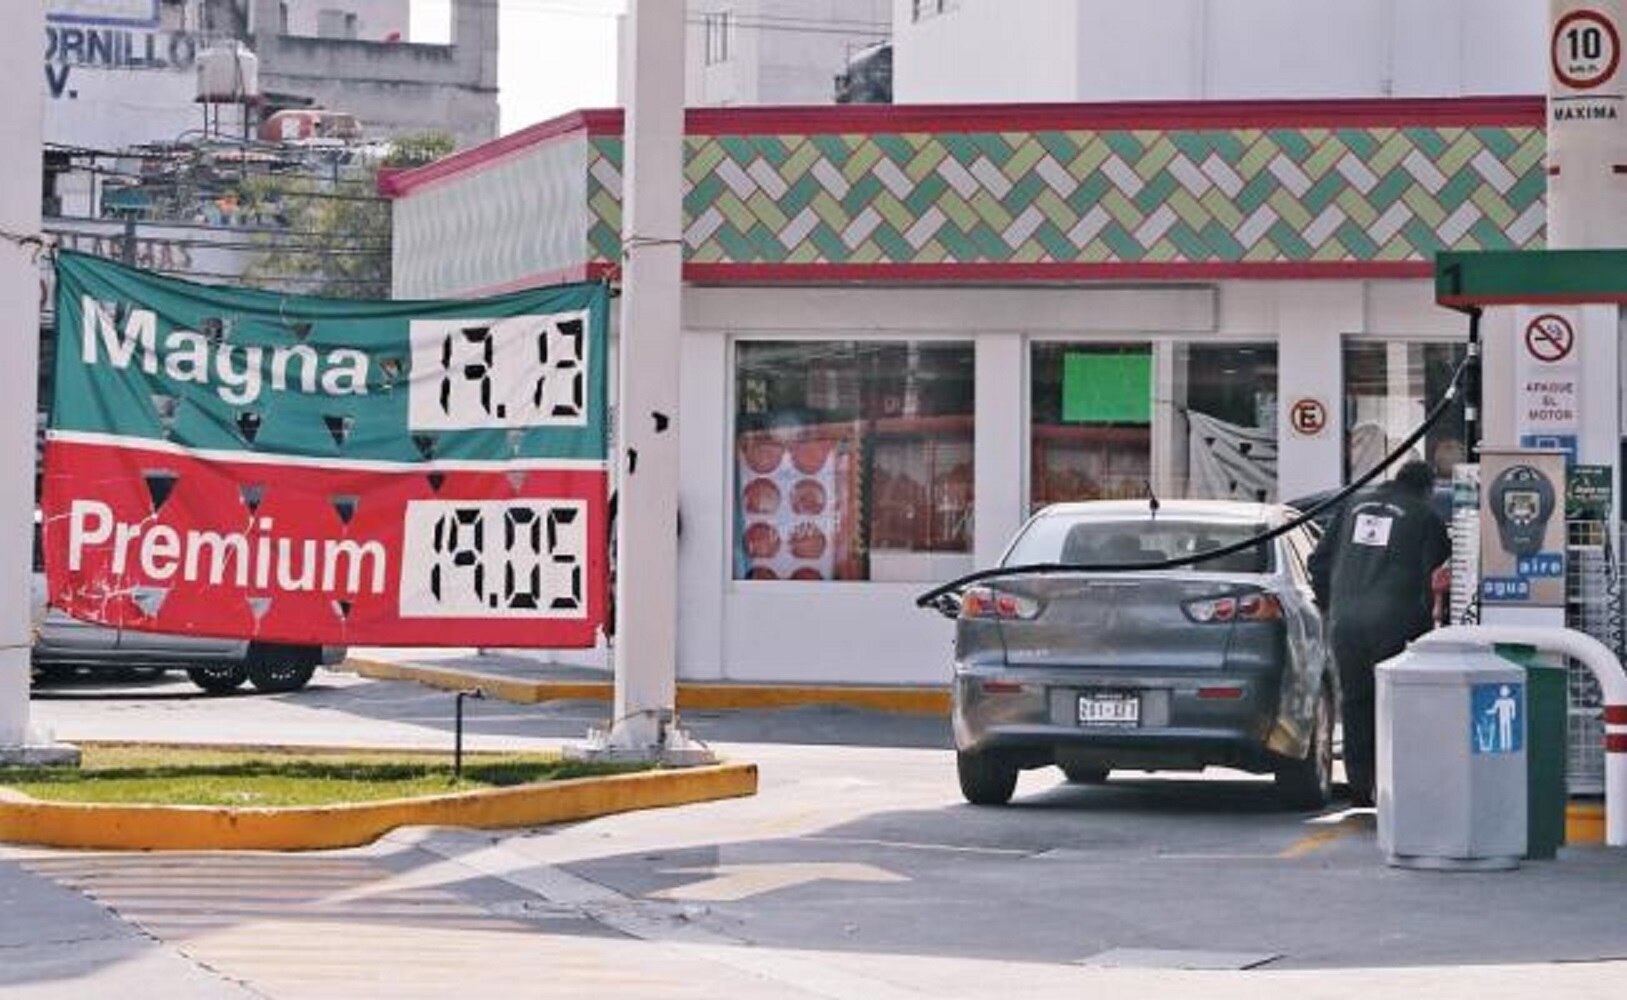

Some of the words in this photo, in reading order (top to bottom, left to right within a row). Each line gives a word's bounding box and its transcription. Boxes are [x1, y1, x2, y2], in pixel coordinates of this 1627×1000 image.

[1567, 27, 1600, 60] 10
[1444, 263, 1461, 295] 1
[82, 295, 368, 405] Magna
[1300, 406, 1317, 428] E
[68, 500, 387, 594] Premium
[431, 507, 581, 608] 19.05
[1519, 557, 1561, 574] aire
[1484, 582, 1528, 597] agua
